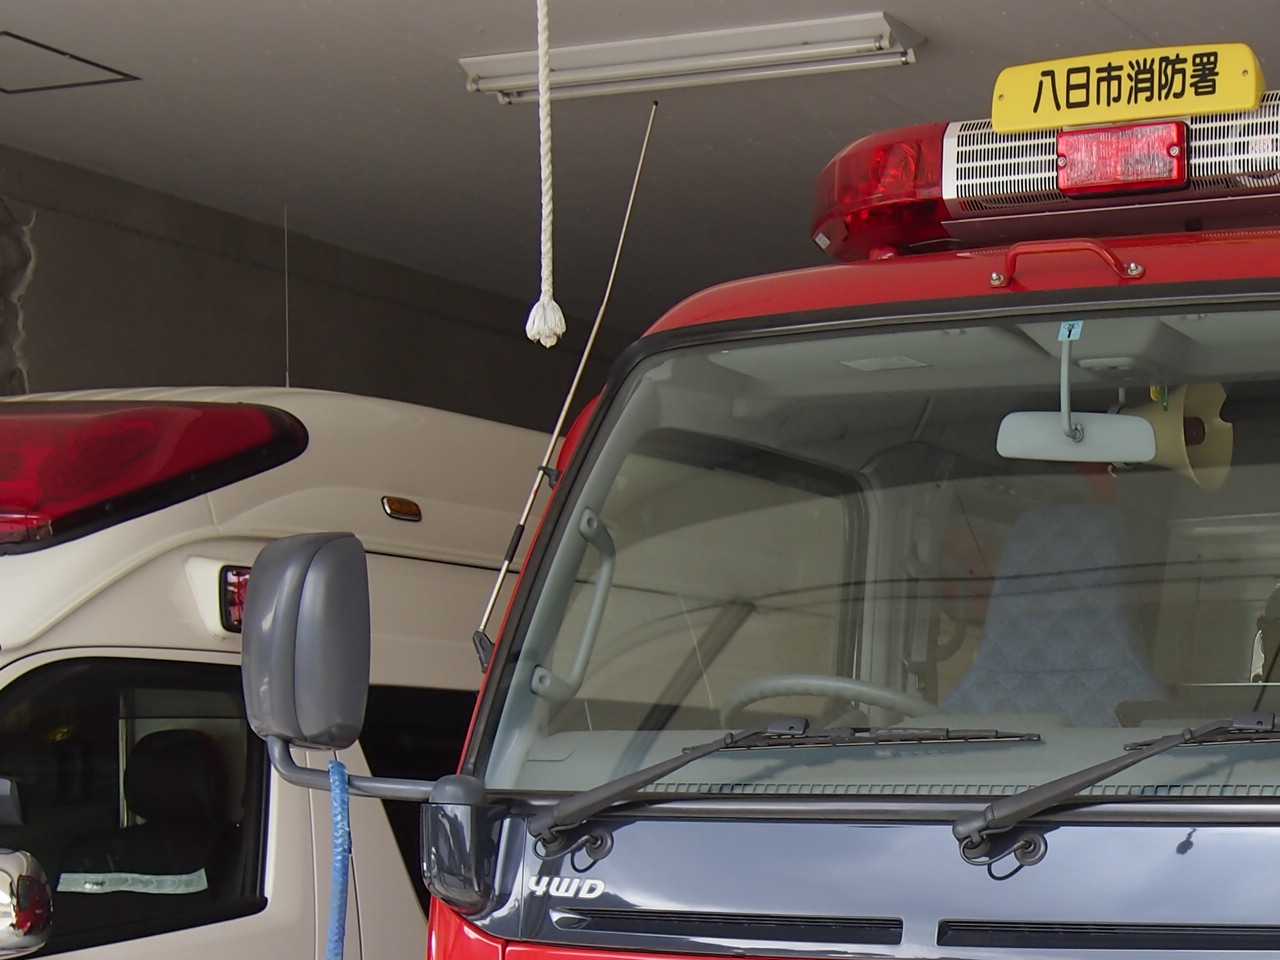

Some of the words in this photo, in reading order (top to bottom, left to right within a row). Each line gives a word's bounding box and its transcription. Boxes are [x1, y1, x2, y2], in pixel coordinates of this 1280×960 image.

[1033, 51, 1220, 114] 八日市消防署
[528, 876, 605, 899] 4WD
